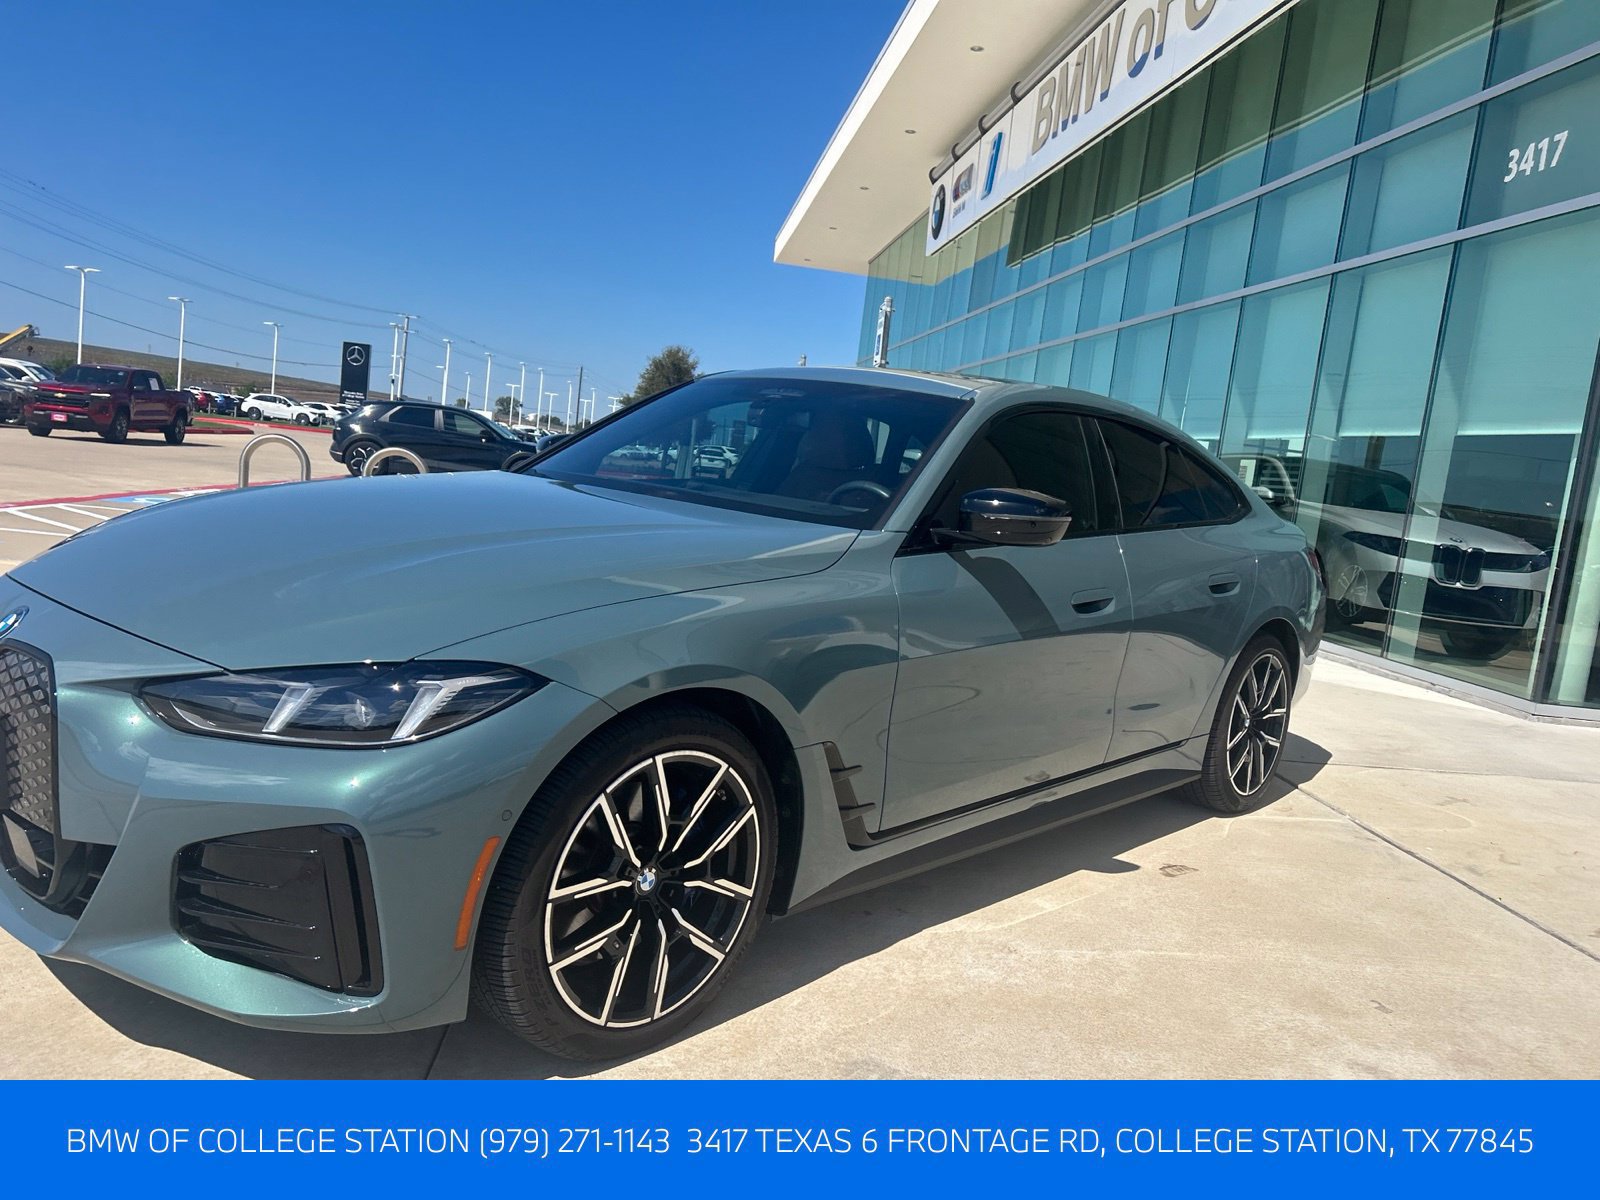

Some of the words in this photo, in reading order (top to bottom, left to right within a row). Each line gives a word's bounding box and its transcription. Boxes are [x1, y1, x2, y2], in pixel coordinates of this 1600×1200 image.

[1031, 7, 1126, 157] BMW
[1126, 0, 1176, 79] of
[1503, 129, 1569, 184] 3417
